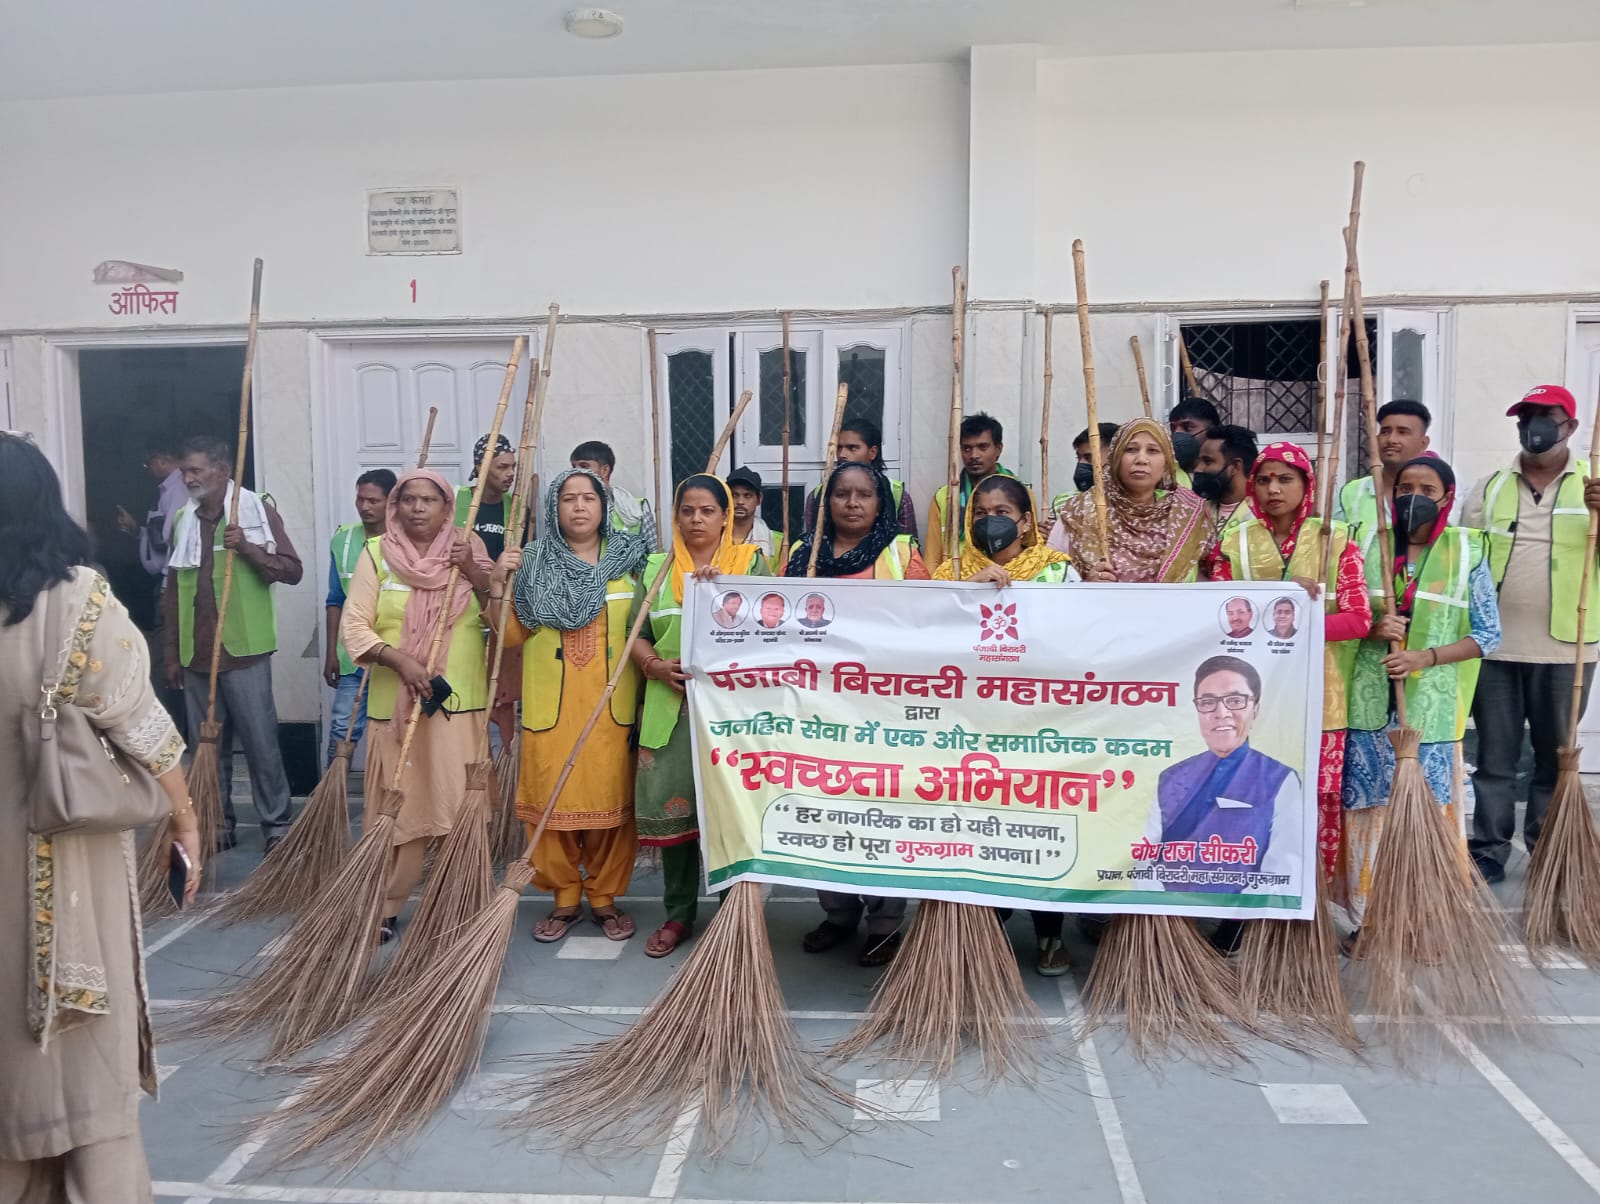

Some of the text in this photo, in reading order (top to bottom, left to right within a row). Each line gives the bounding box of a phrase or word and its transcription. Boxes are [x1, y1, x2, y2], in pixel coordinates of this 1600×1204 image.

[108, 283, 179, 315] ऑफिस
[706, 659, 1180, 707] पंजाबी बिरादरी महासंगठन
[904, 705, 941, 720] द्वारा
[709, 711, 1173, 758] जनहित सेवा में एक और समाजिक कदम
[827, 808, 903, 829] नागरिक
[908, 816, 935, 832] का
[940, 812, 961, 834] हो
[967, 813, 1001, 837] यही
[1005, 822, 1066, 843] सपना,
[777, 830, 829, 849] स्वच्छ
[832, 831, 854, 852] हो
[860, 836, 891, 860] पूरा
[1164, 841, 1196, 862] राज
[1200, 833, 1258, 864] सीकरी
[1126, 866, 1154, 880] पंजाबी
[1156, 866, 1189, 882] बिरादरी
